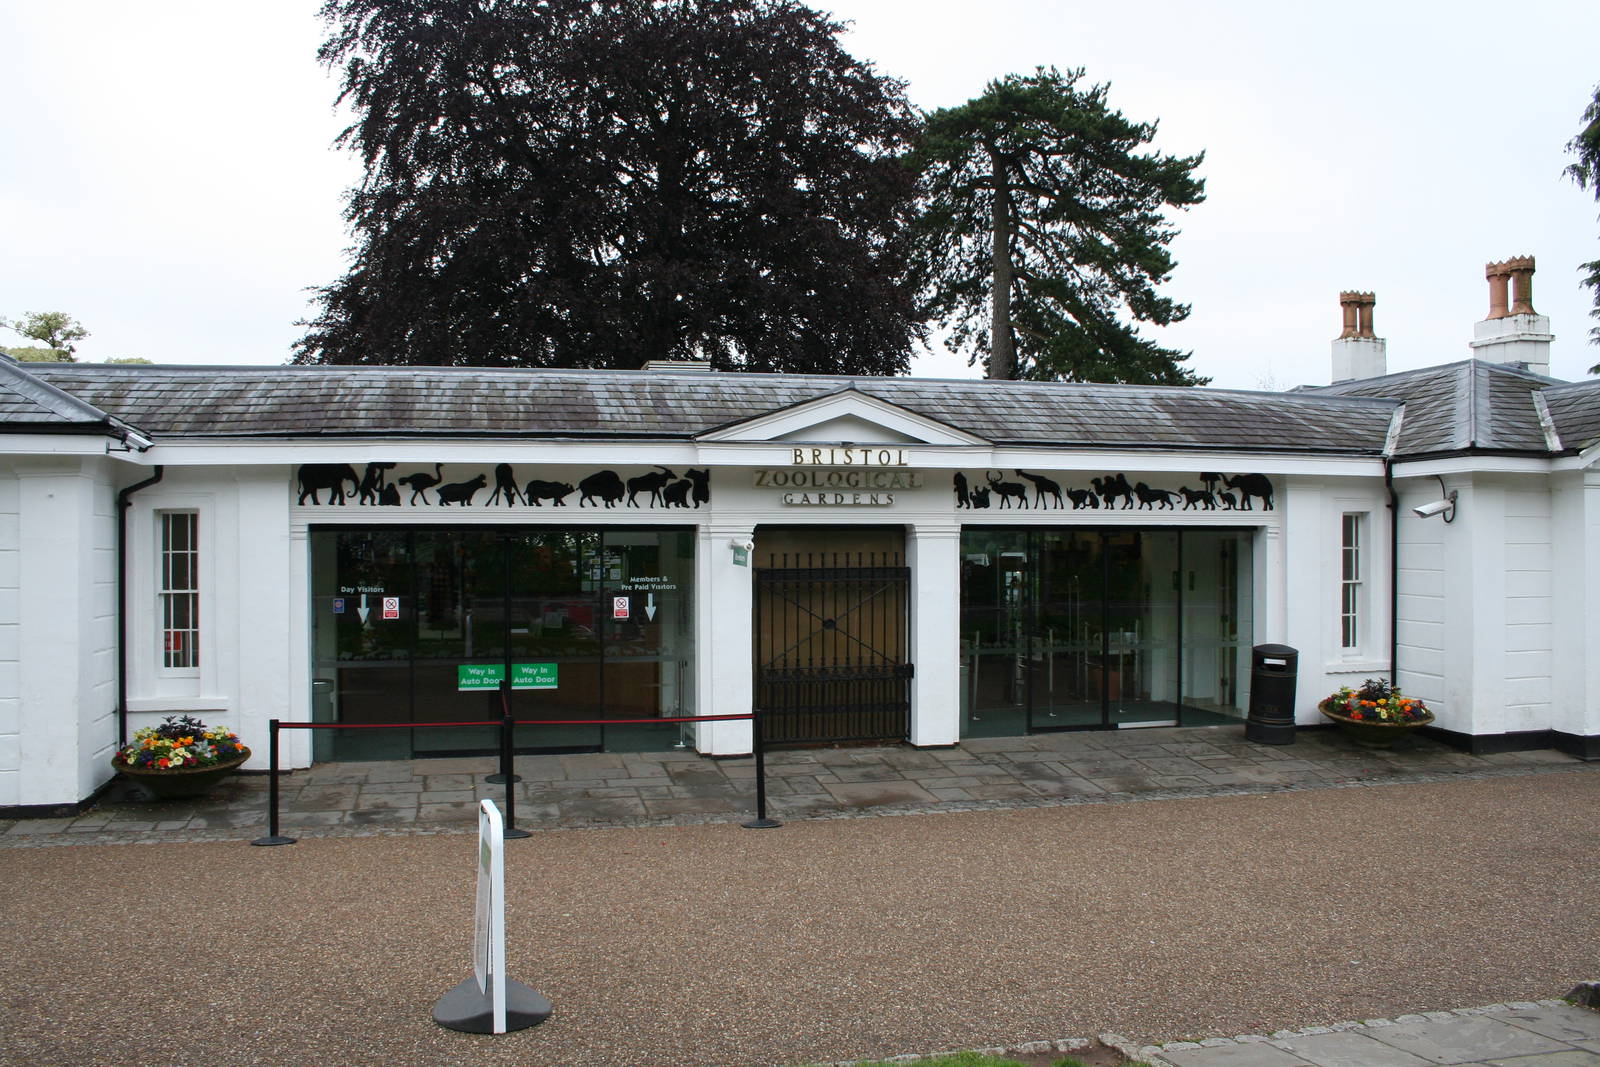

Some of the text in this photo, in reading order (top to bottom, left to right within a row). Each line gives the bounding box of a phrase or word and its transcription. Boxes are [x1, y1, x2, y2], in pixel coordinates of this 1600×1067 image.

[793, 448, 908, 466] BRISTOL
[754, 470, 922, 488] ZOOLOGICAL
[783, 493, 894, 505] GARDENS
[340, 586, 355, 594] Day
[468, 668, 485, 676] Way
[521, 666, 538, 675] Way
